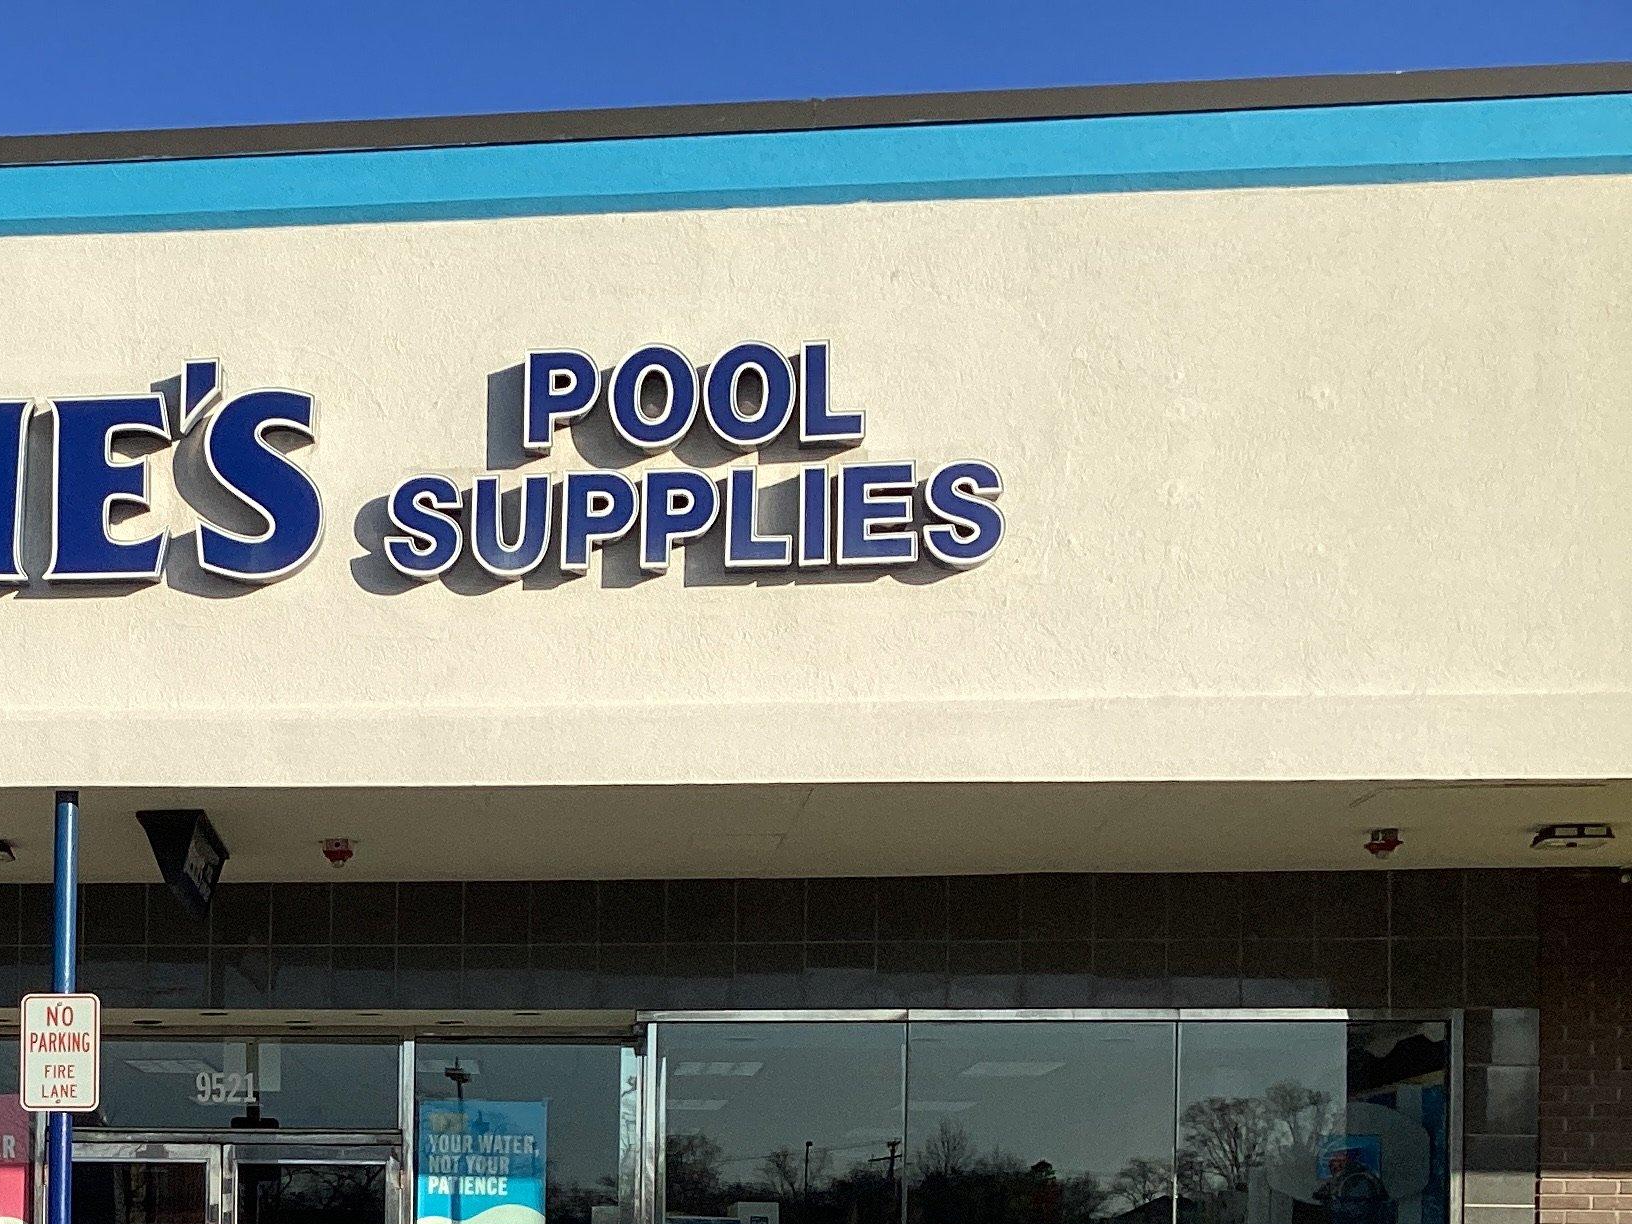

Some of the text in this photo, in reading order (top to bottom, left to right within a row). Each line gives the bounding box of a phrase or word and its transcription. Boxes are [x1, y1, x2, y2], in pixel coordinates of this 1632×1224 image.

[523, 340, 866, 451] POOL
[384, 459, 1006, 577] SUPPLIES
[46, 1006, 74, 1027] NO
[30, 1032, 90, 1053] PARKING
[44, 1064, 75, 1079] FIRE
[41, 1084, 78, 1098] LANE
[195, 1071, 257, 1103] 9521
[428, 1134, 540, 1158] YOUR WATER,
[428, 1155, 509, 1174] NOT YOUR
[428, 1175, 508, 1196] PATIENCE
